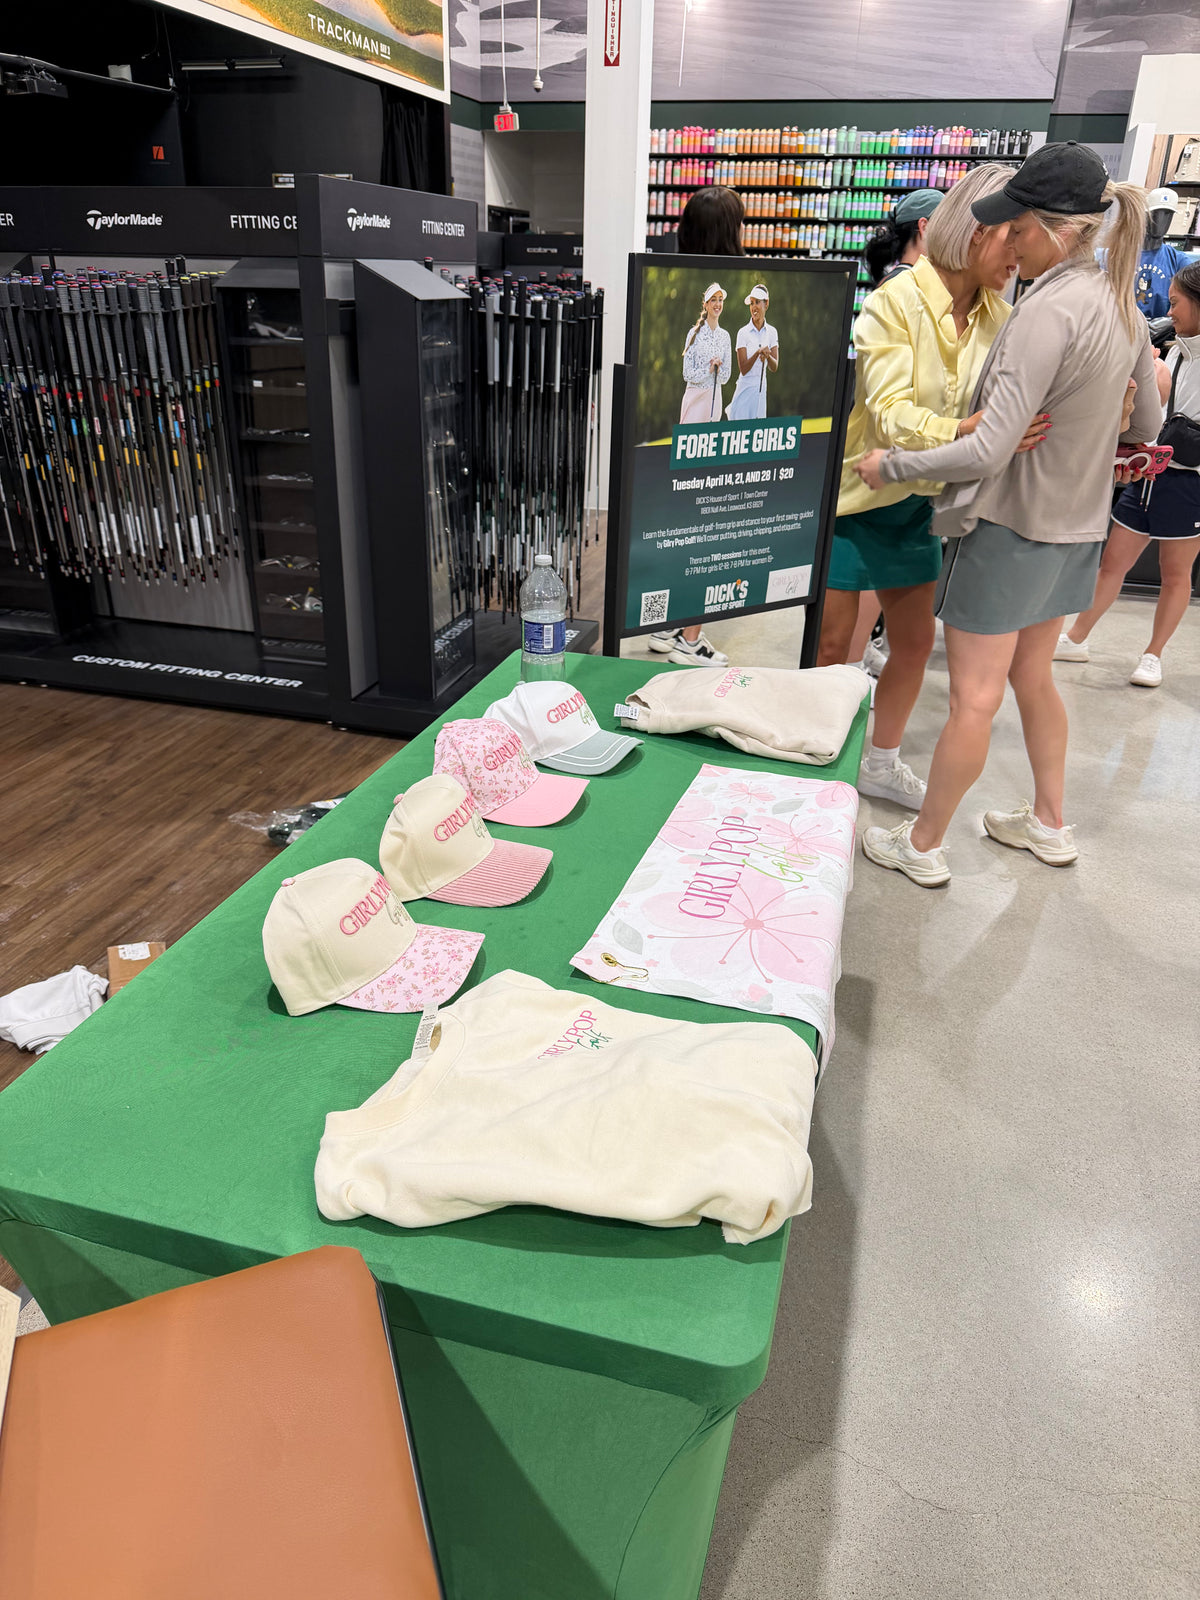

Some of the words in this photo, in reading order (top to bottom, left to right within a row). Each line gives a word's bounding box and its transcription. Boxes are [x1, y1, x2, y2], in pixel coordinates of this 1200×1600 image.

[308, 13, 379, 55] TRACKMAN
[86, 209, 163, 230] TaylorMade
[230, 215, 280, 230] FITTING
[347, 208, 391, 231] TaylorMade
[421, 219, 443, 235] FITTING
[444, 222, 465, 237] CENTER
[676, 432, 719, 460] FORE
[721, 430, 750, 455] THE
[752, 426, 797, 453] GIRLS
[672, 477, 705, 491] Tuesday
[705, 474, 724, 489] April
[724, 473, 734, 486] 14,
[735, 472, 745, 485] 21,
[745, 471, 761, 483] AND
[761, 469, 771, 481] 28
[779, 467, 794, 480] $20
[728, 493, 740, 502] Sport
[642, 531, 657, 540] Learn
[657, 529, 666, 538] the
[666, 525, 699, 536] fundamentals
[656, 540, 663, 549] by
[675, 537, 685, 547] Pop
[707, 533, 719, 542] cover
[689, 556, 702, 565] There
[721, 551, 742, 560] sessions
[704, 578, 749, 606] DICK'S
[704, 604, 721, 614] HOUSE
[721, 602, 729, 611] OF
[728, 600, 745, 609] SPORT
[72, 654, 151, 669] CUSTOM
[150, 663, 223, 678] FITTING
[224, 672, 303, 687] CENTER
